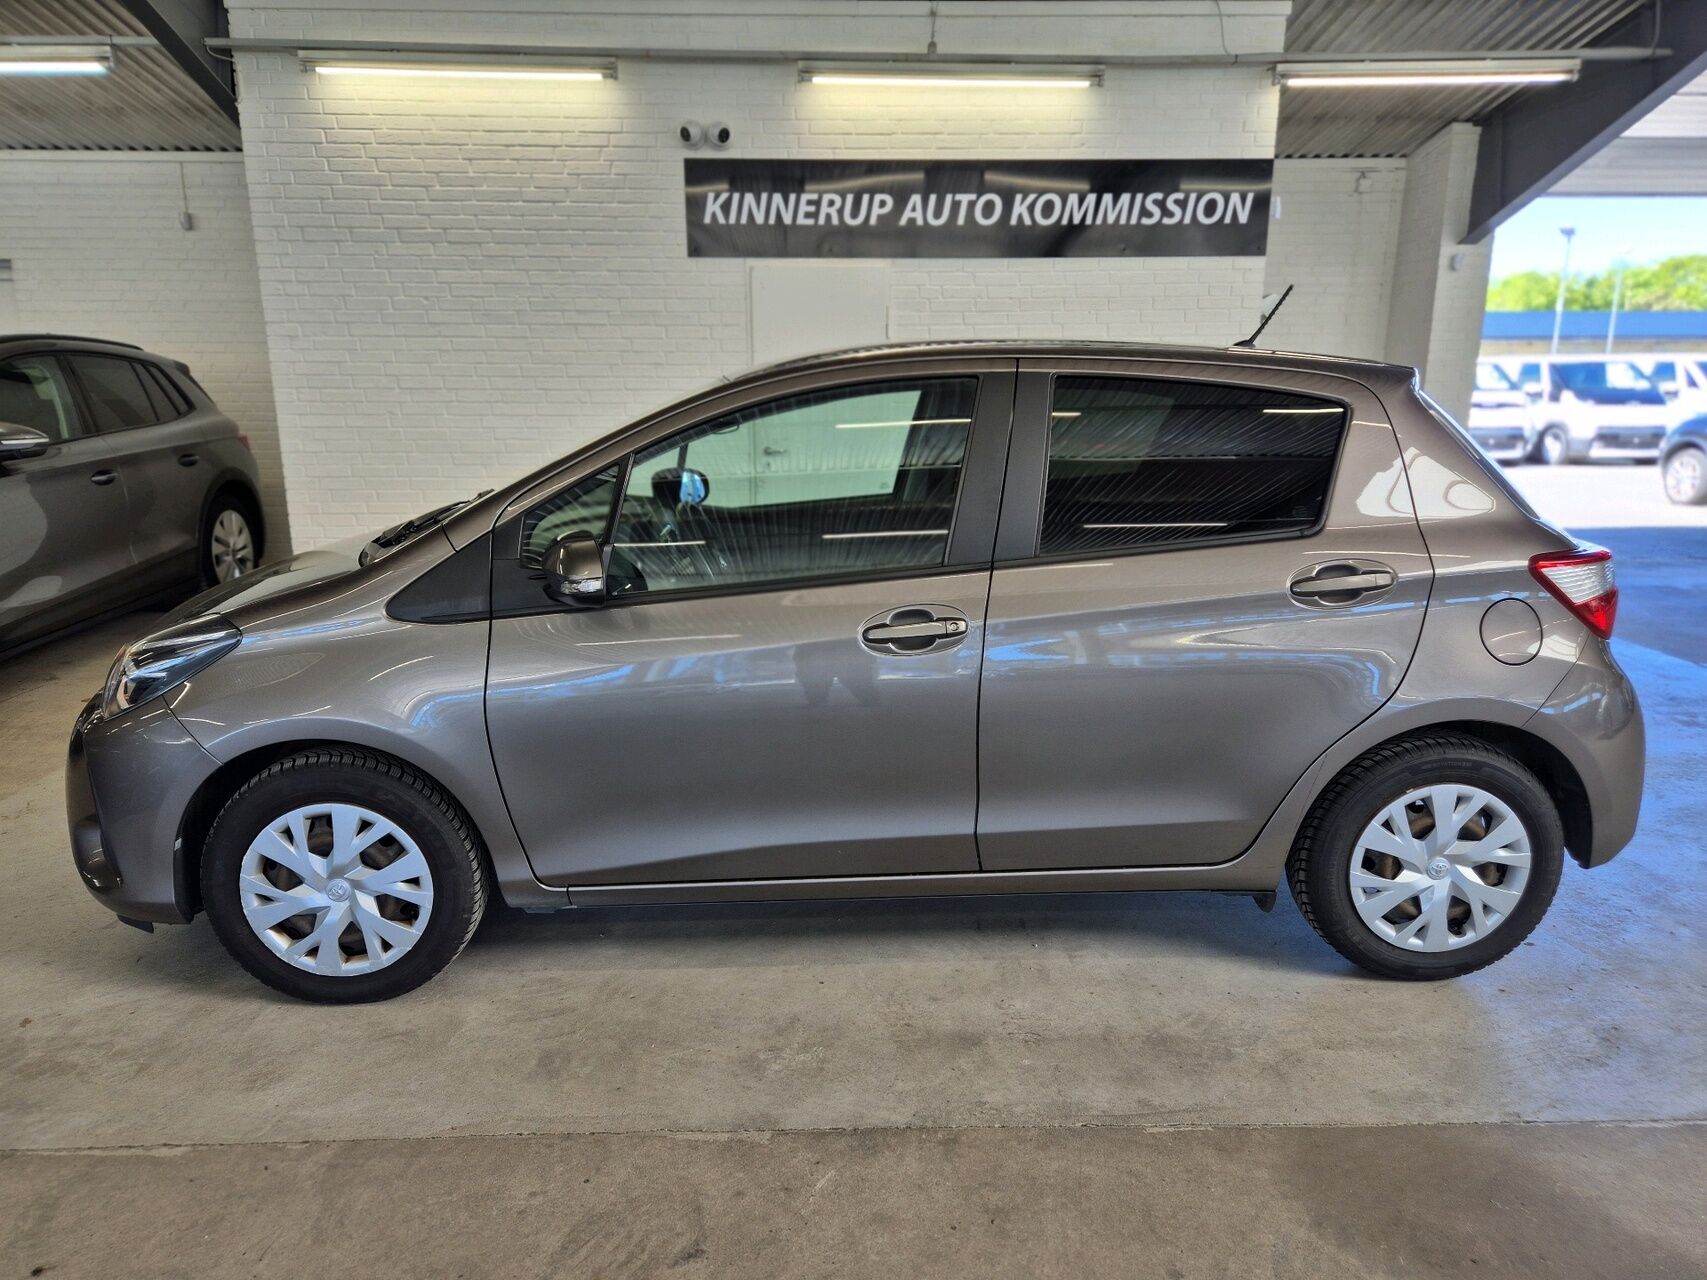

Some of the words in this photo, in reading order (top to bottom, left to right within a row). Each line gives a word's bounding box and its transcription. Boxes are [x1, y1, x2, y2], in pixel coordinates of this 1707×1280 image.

[703, 191, 894, 226] KINNERUP
[898, 192, 1003, 227] AUTO
[1009, 191, 1255, 226] KOMMISSION
